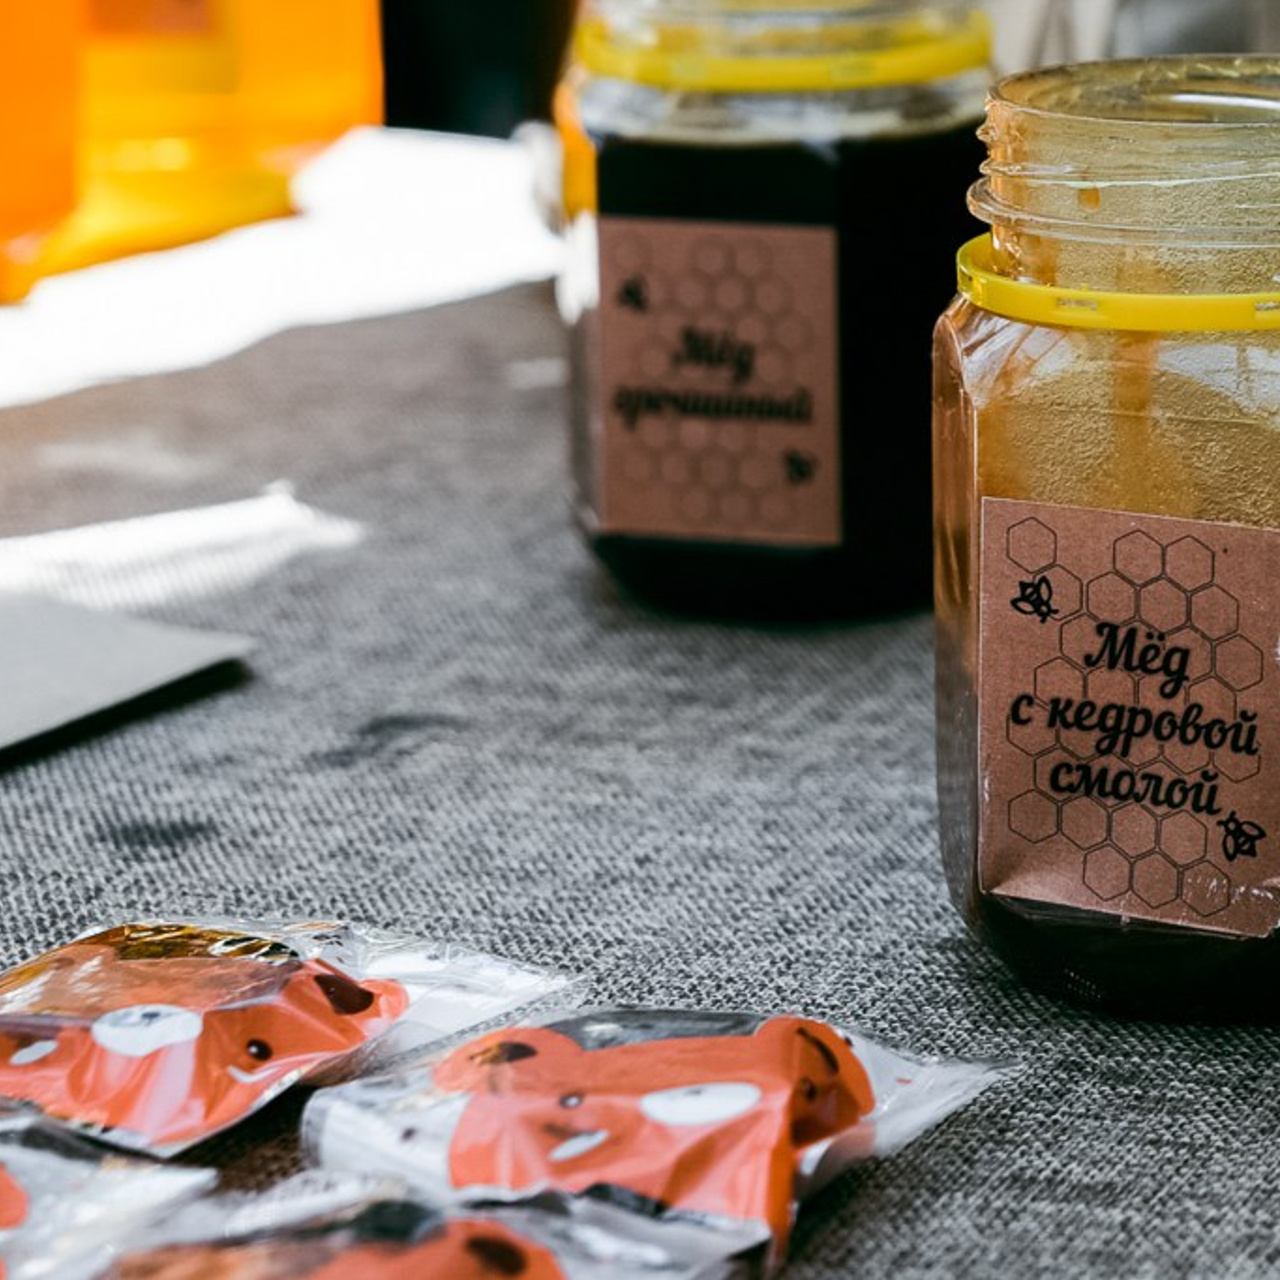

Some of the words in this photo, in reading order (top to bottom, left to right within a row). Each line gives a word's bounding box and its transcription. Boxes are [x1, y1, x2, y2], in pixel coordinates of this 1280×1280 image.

[1084, 622, 1190, 699] Мёд
[1010, 694, 1034, 727] с
[1047, 696, 1260, 758] кедровой
[1049, 760, 1221, 817] смолой
